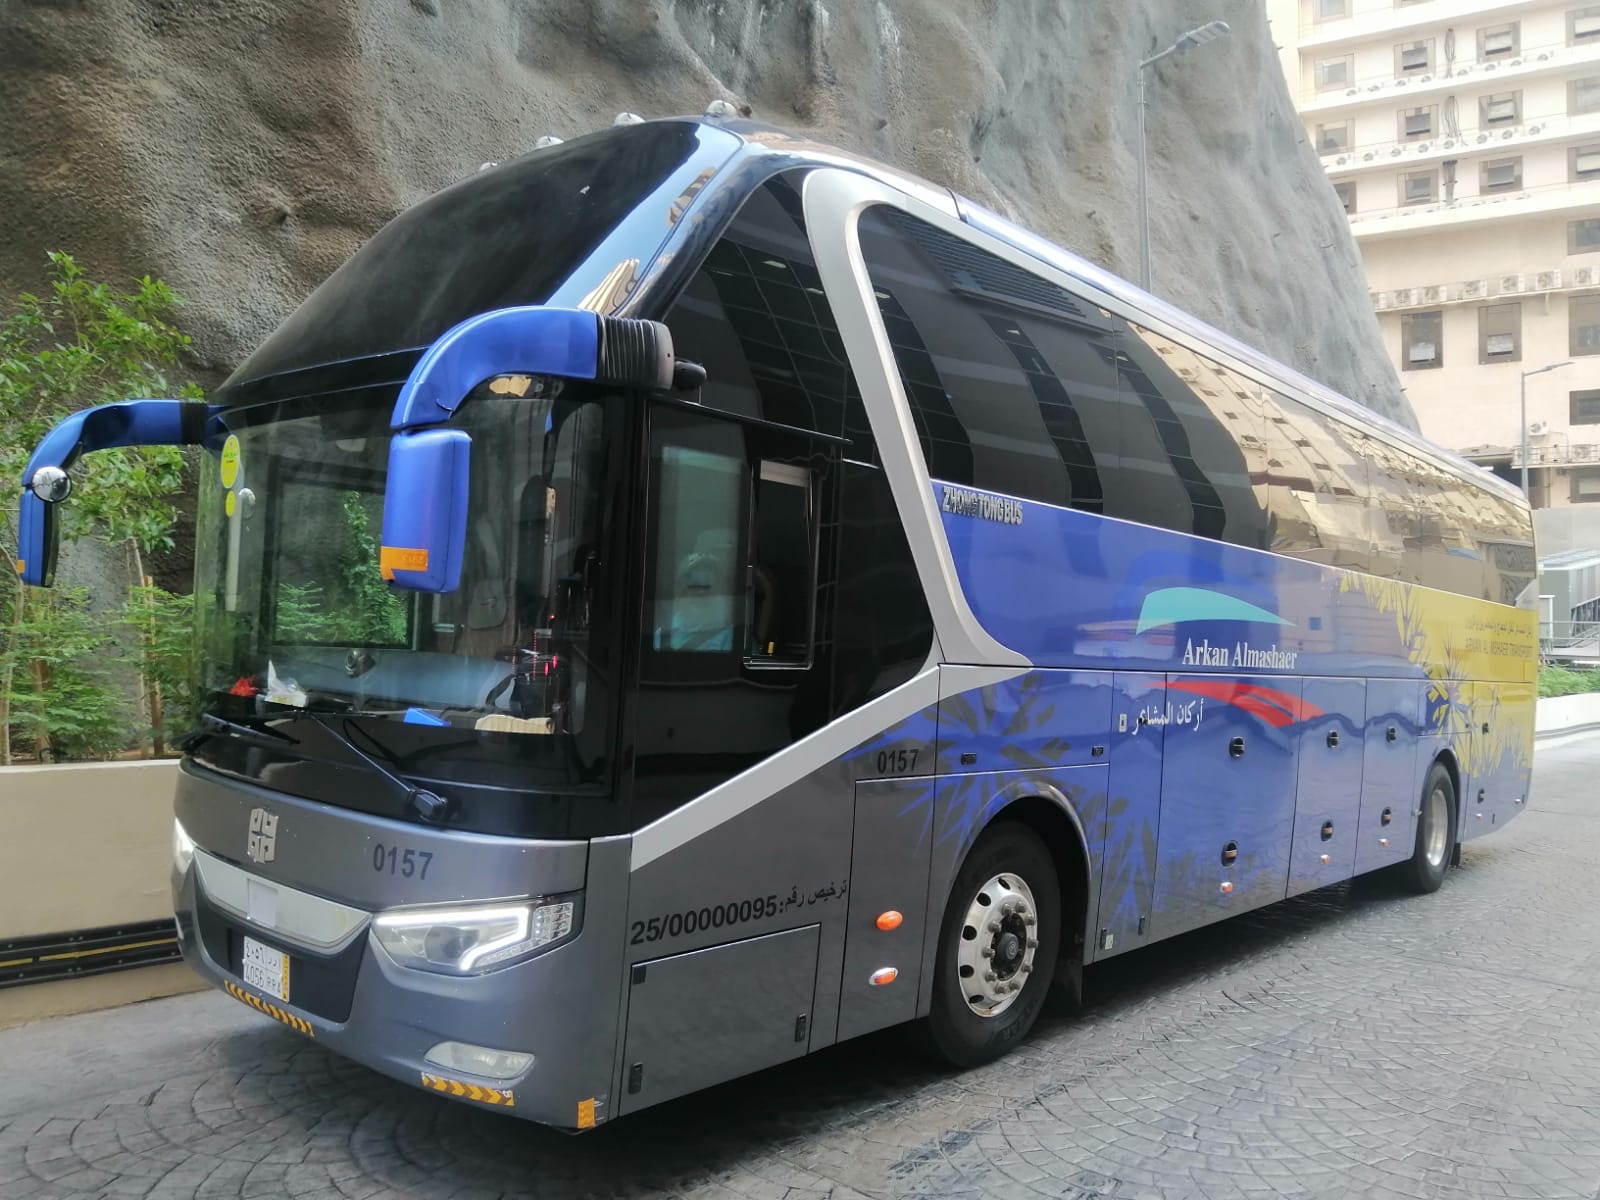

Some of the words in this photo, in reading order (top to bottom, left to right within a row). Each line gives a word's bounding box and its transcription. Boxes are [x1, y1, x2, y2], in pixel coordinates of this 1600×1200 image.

[1182, 637, 1229, 666] Arkan
[1232, 641, 1297, 669] Almashaer
[1177, 697, 1205, 732] أركان
[877, 749, 920, 773] 0157
[373, 843, 433, 880] 0157
[245, 964, 265, 988] 4056
